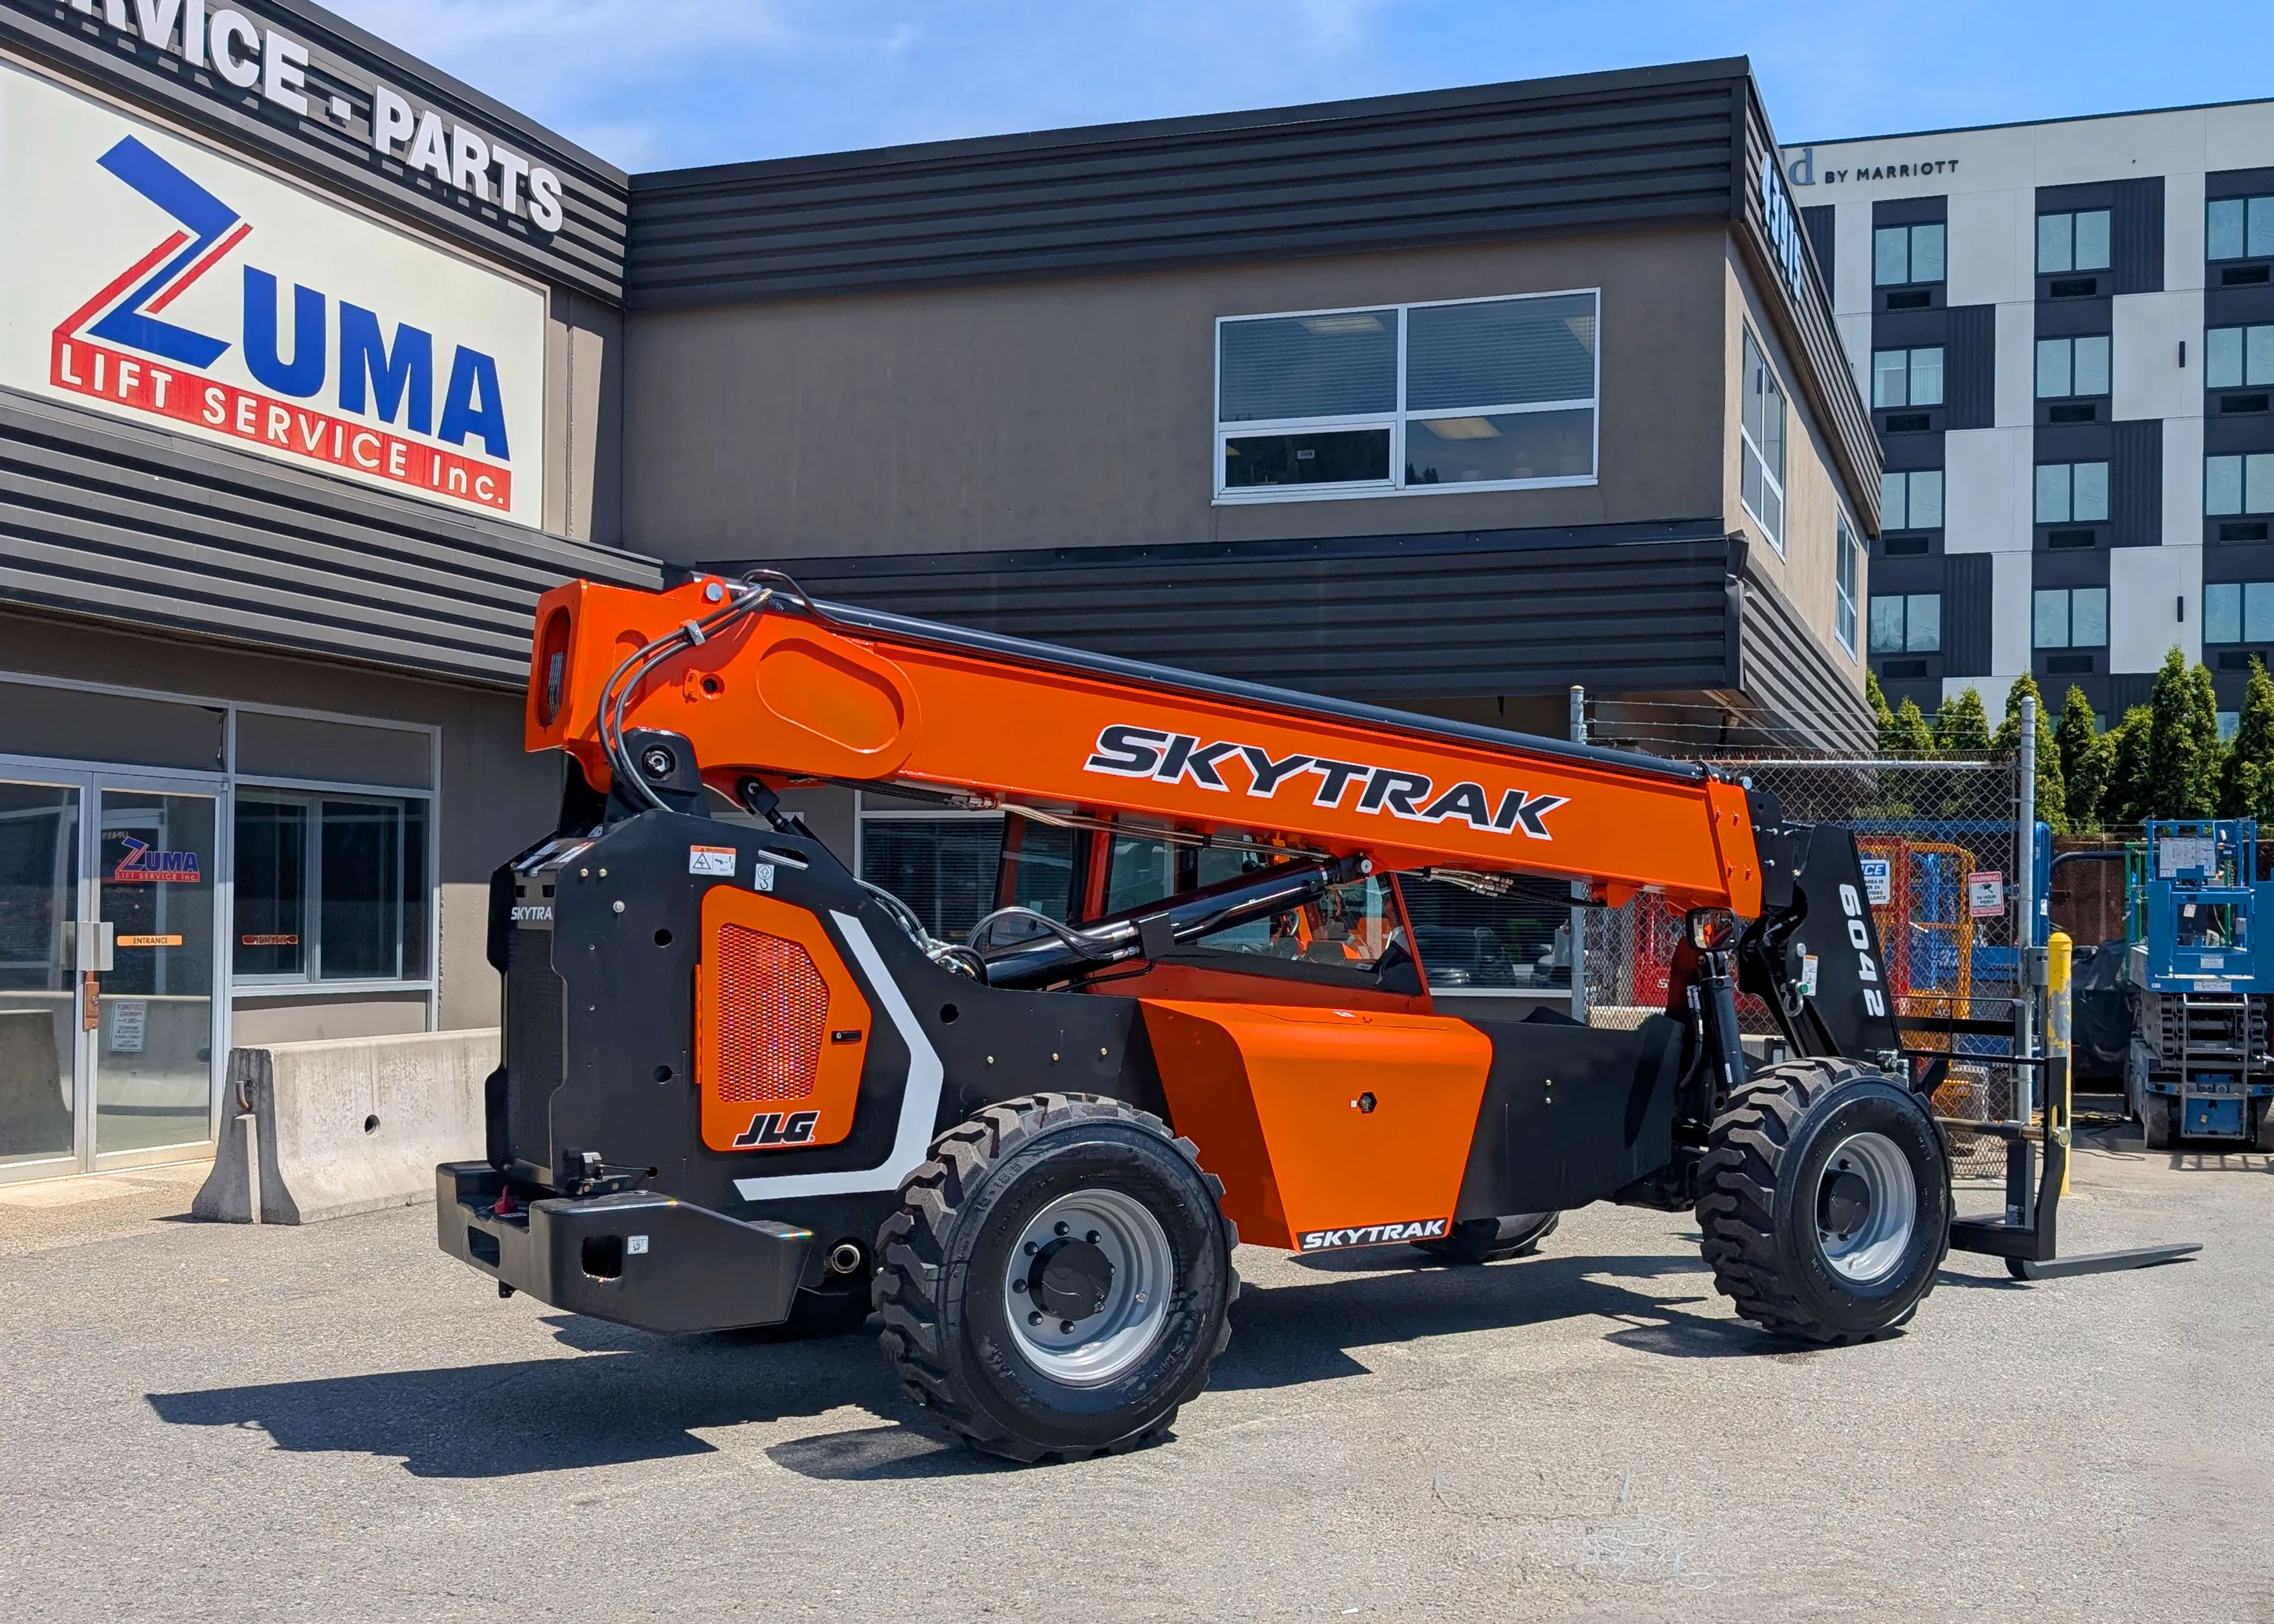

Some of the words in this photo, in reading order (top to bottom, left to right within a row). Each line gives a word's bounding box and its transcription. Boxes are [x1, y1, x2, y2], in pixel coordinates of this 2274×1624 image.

[373, 85, 563, 233] PARTS
[1825, 170, 1848, 184] BY
[1856, 160, 1959, 182] MARRIOTT
[86, 134, 511, 462] ZUMA
[60, 343, 173, 409] LIFT
[203, 386, 407, 478] SERVICE
[432, 456, 505, 505] Inc.
[1084, 723, 1571, 841] SKYTRAK
[122, 836, 199, 873] ZUMA
[510, 906, 553, 920] SKYTRA
[1839, 884, 1886, 1017] 6042
[1303, 1219, 1445, 1249] SKYTRAK
